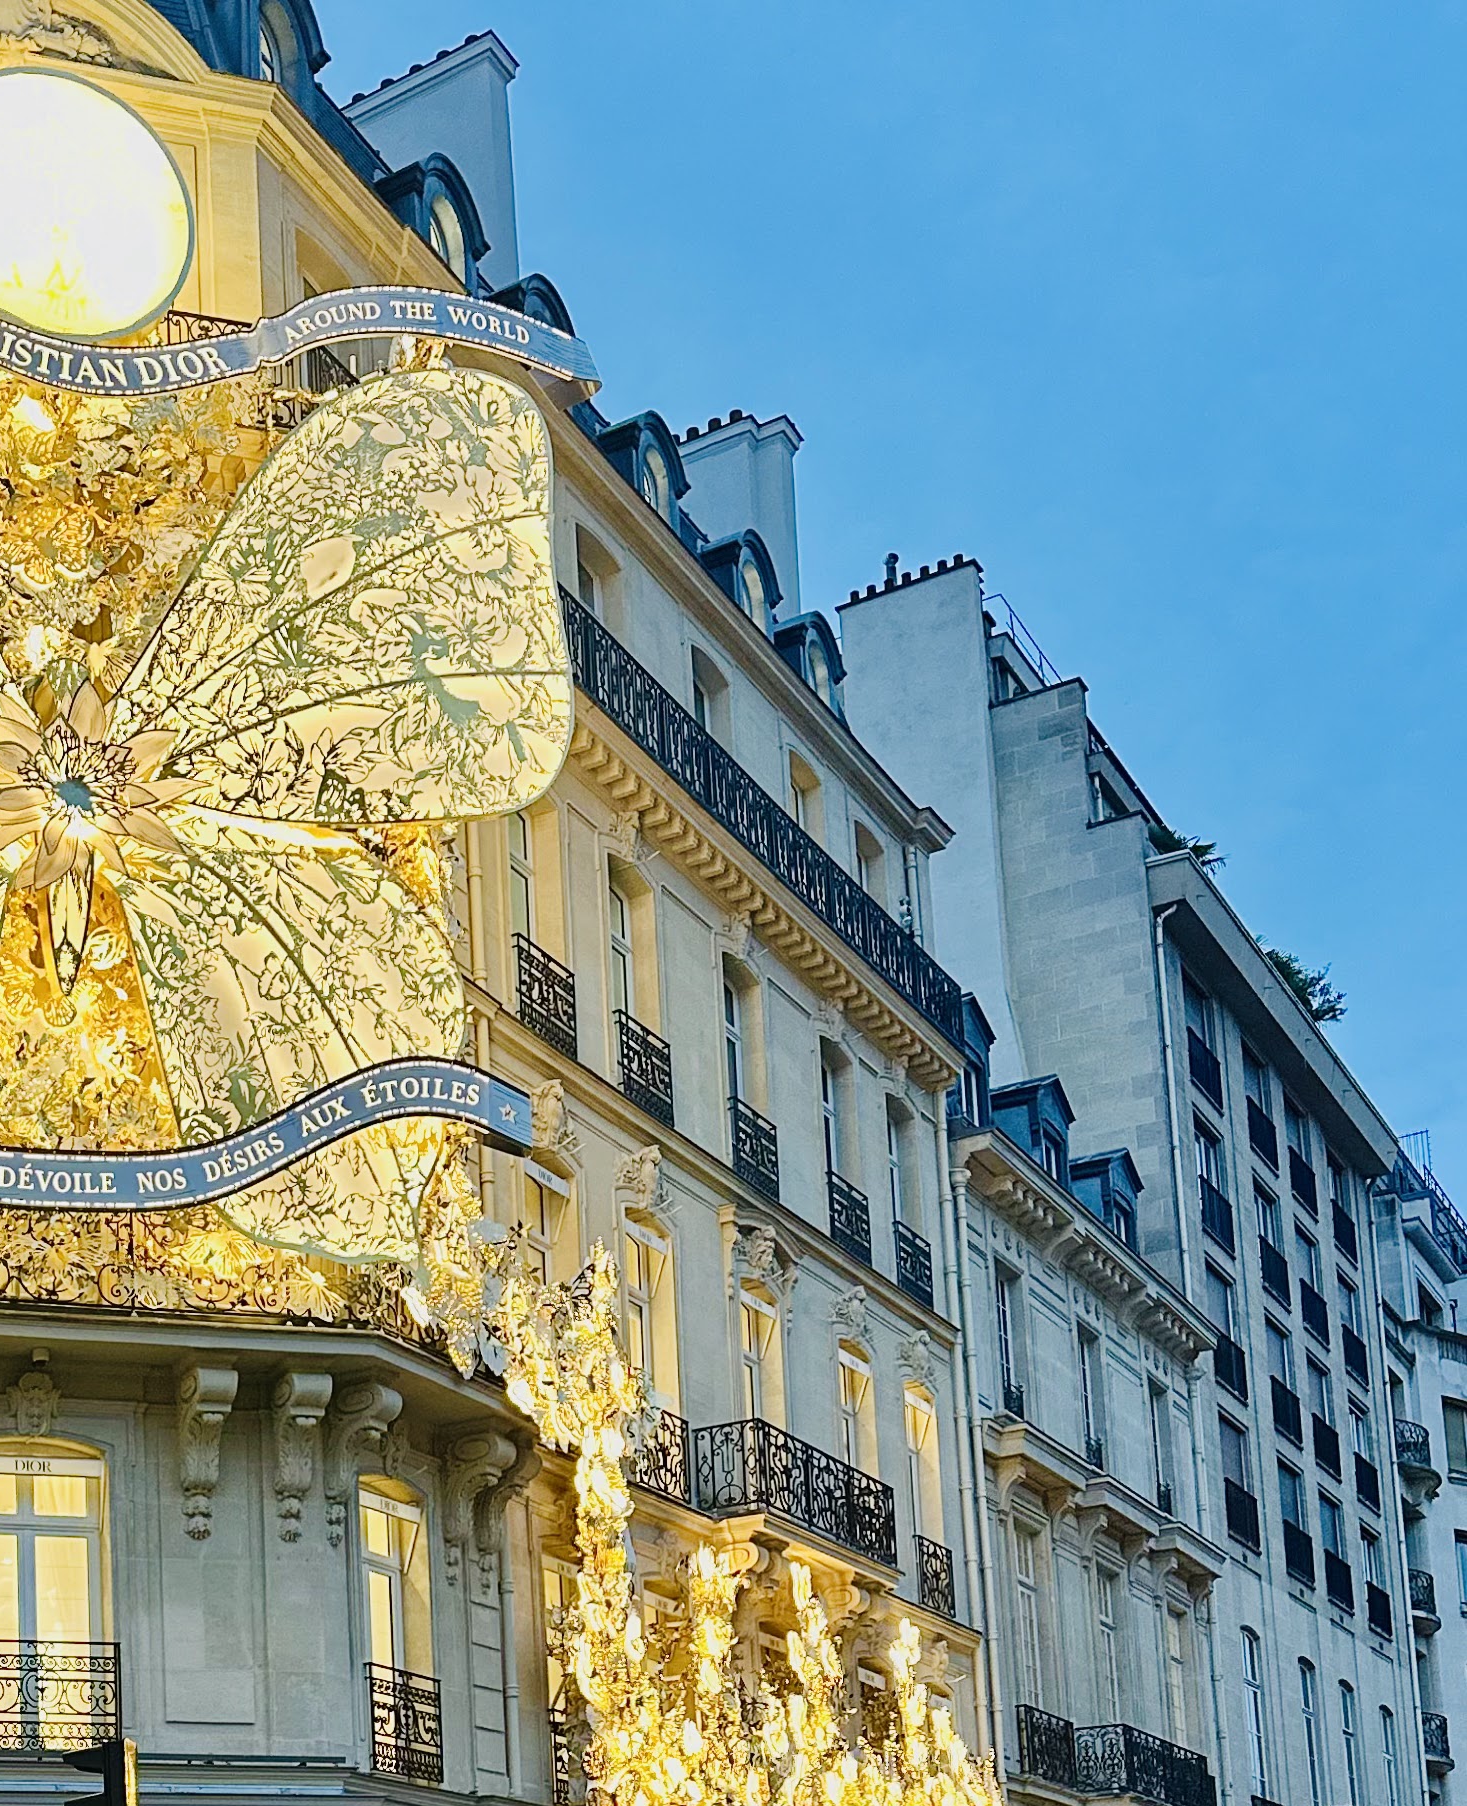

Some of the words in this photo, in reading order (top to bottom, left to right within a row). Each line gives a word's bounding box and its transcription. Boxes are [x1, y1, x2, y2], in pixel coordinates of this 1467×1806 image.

[283, 300, 381, 345] AROUND
[389, 299, 437, 322] THE
[449, 307, 531, 345] WORLD
[135, 346, 232, 389] DIOR
[136, 1168, 187, 1193] NOS
[202, 1133, 286, 1182] DÉSIRS
[299, 1097, 353, 1138] AUX
[361, 1075, 481, 1108] ÉTOILES
[14, 1459, 53, 1473] DIOR
